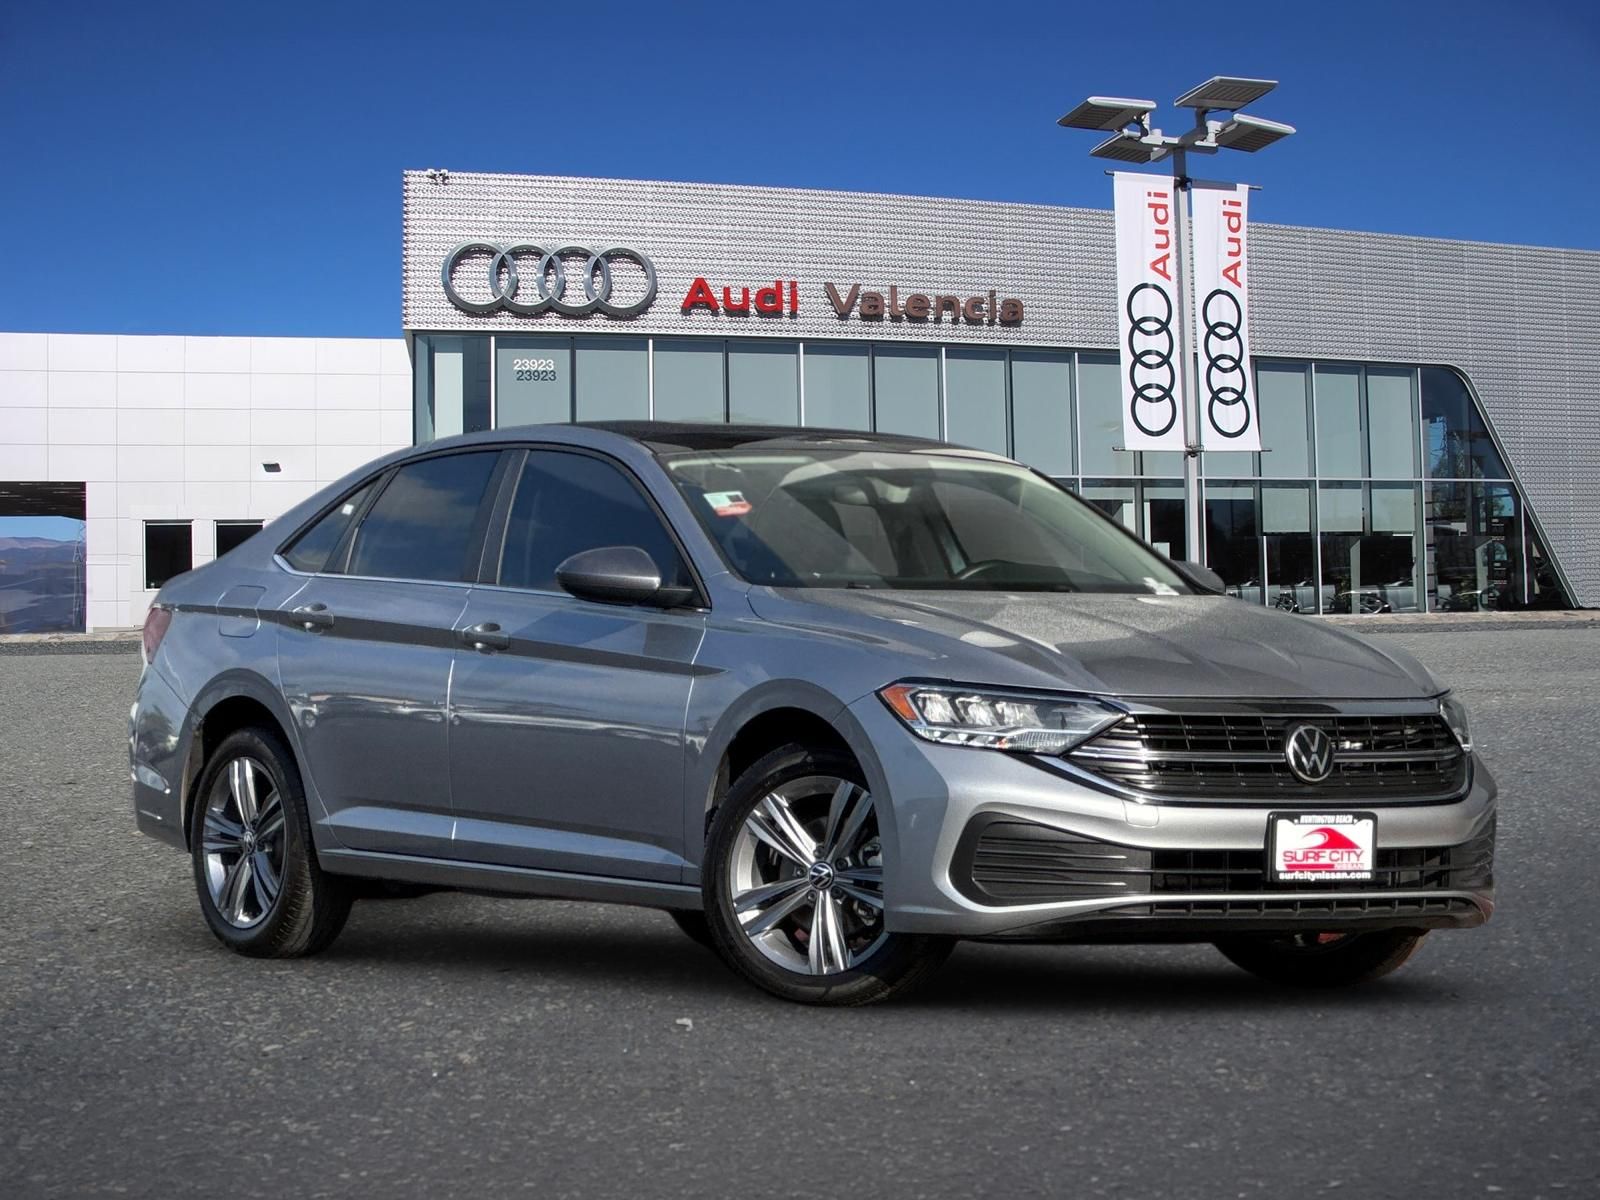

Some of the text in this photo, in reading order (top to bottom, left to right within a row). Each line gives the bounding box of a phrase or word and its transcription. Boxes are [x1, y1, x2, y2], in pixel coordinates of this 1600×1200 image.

[1147, 190, 1172, 282] Audi
[1221, 199, 1243, 289] Audi
[680, 277, 1025, 323] Audi Valencia
[513, 359, 554, 370] 23923
[516, 370, 557, 381] 23923
[1283, 850, 1364, 862] SURF CITY
[1279, 871, 1371, 881] surfcitynissan.com
